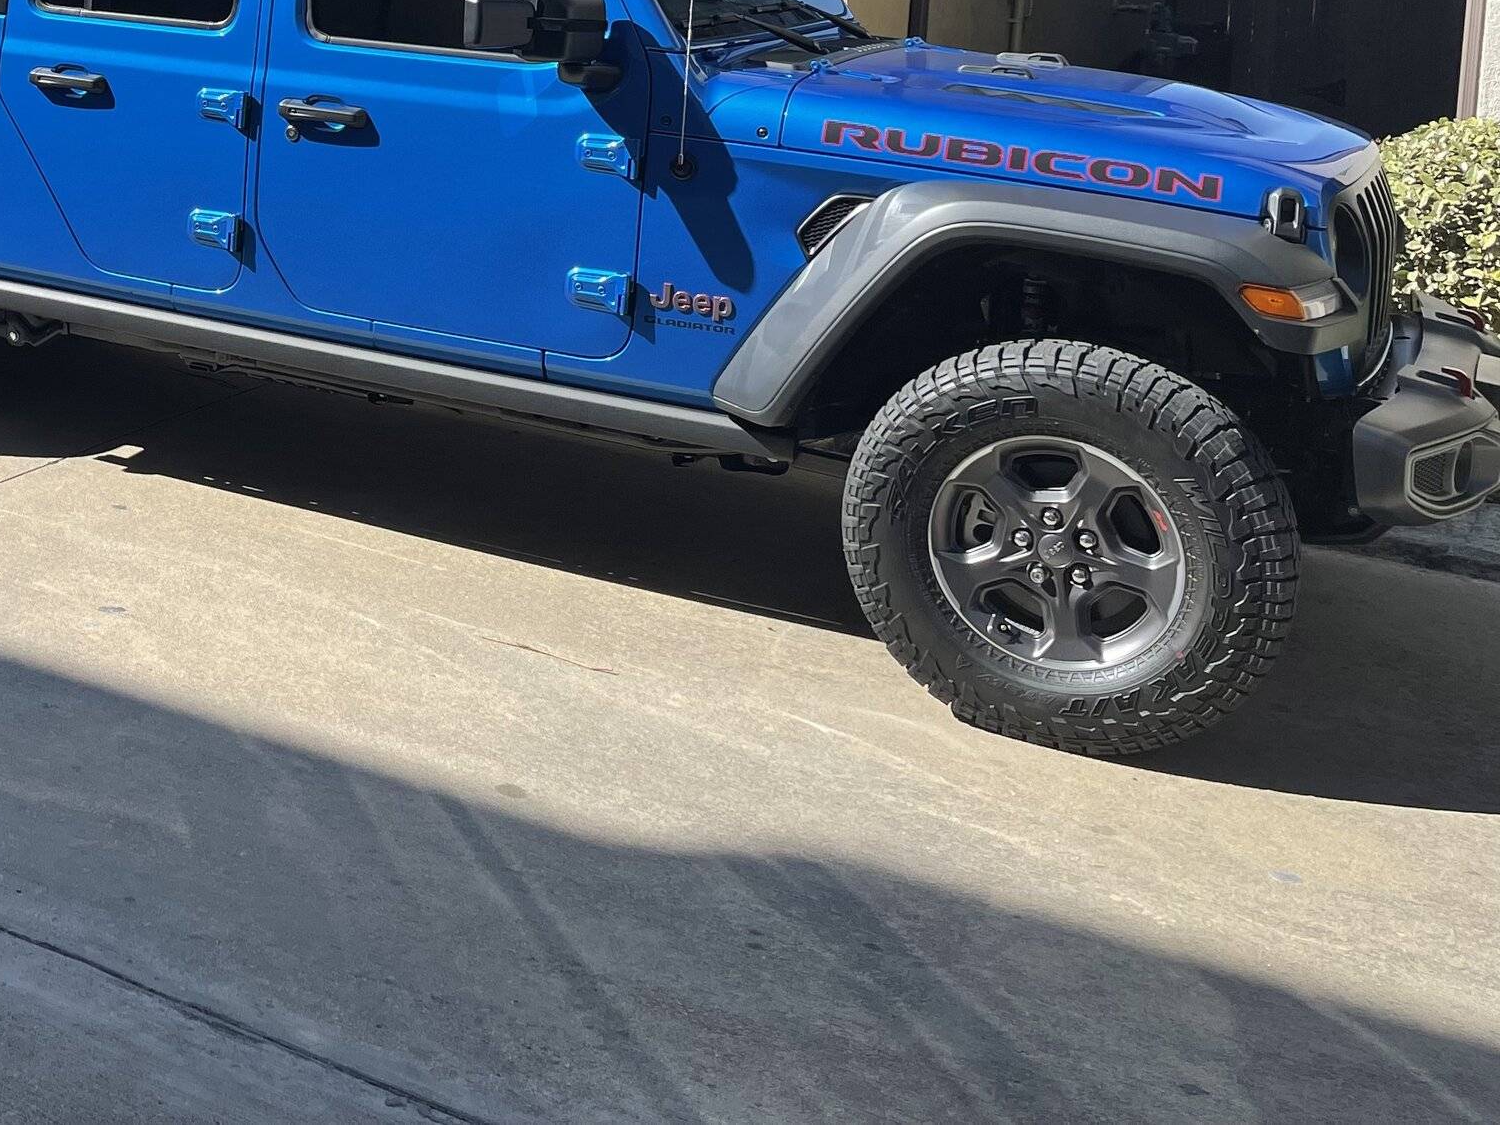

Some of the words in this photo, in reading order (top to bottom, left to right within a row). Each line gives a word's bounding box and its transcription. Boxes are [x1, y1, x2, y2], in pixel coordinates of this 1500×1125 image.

[821, 119, 1223, 203] RUBICON
[649, 282, 734, 322] Jeep
[643, 315, 736, 335] GLADIATOR
